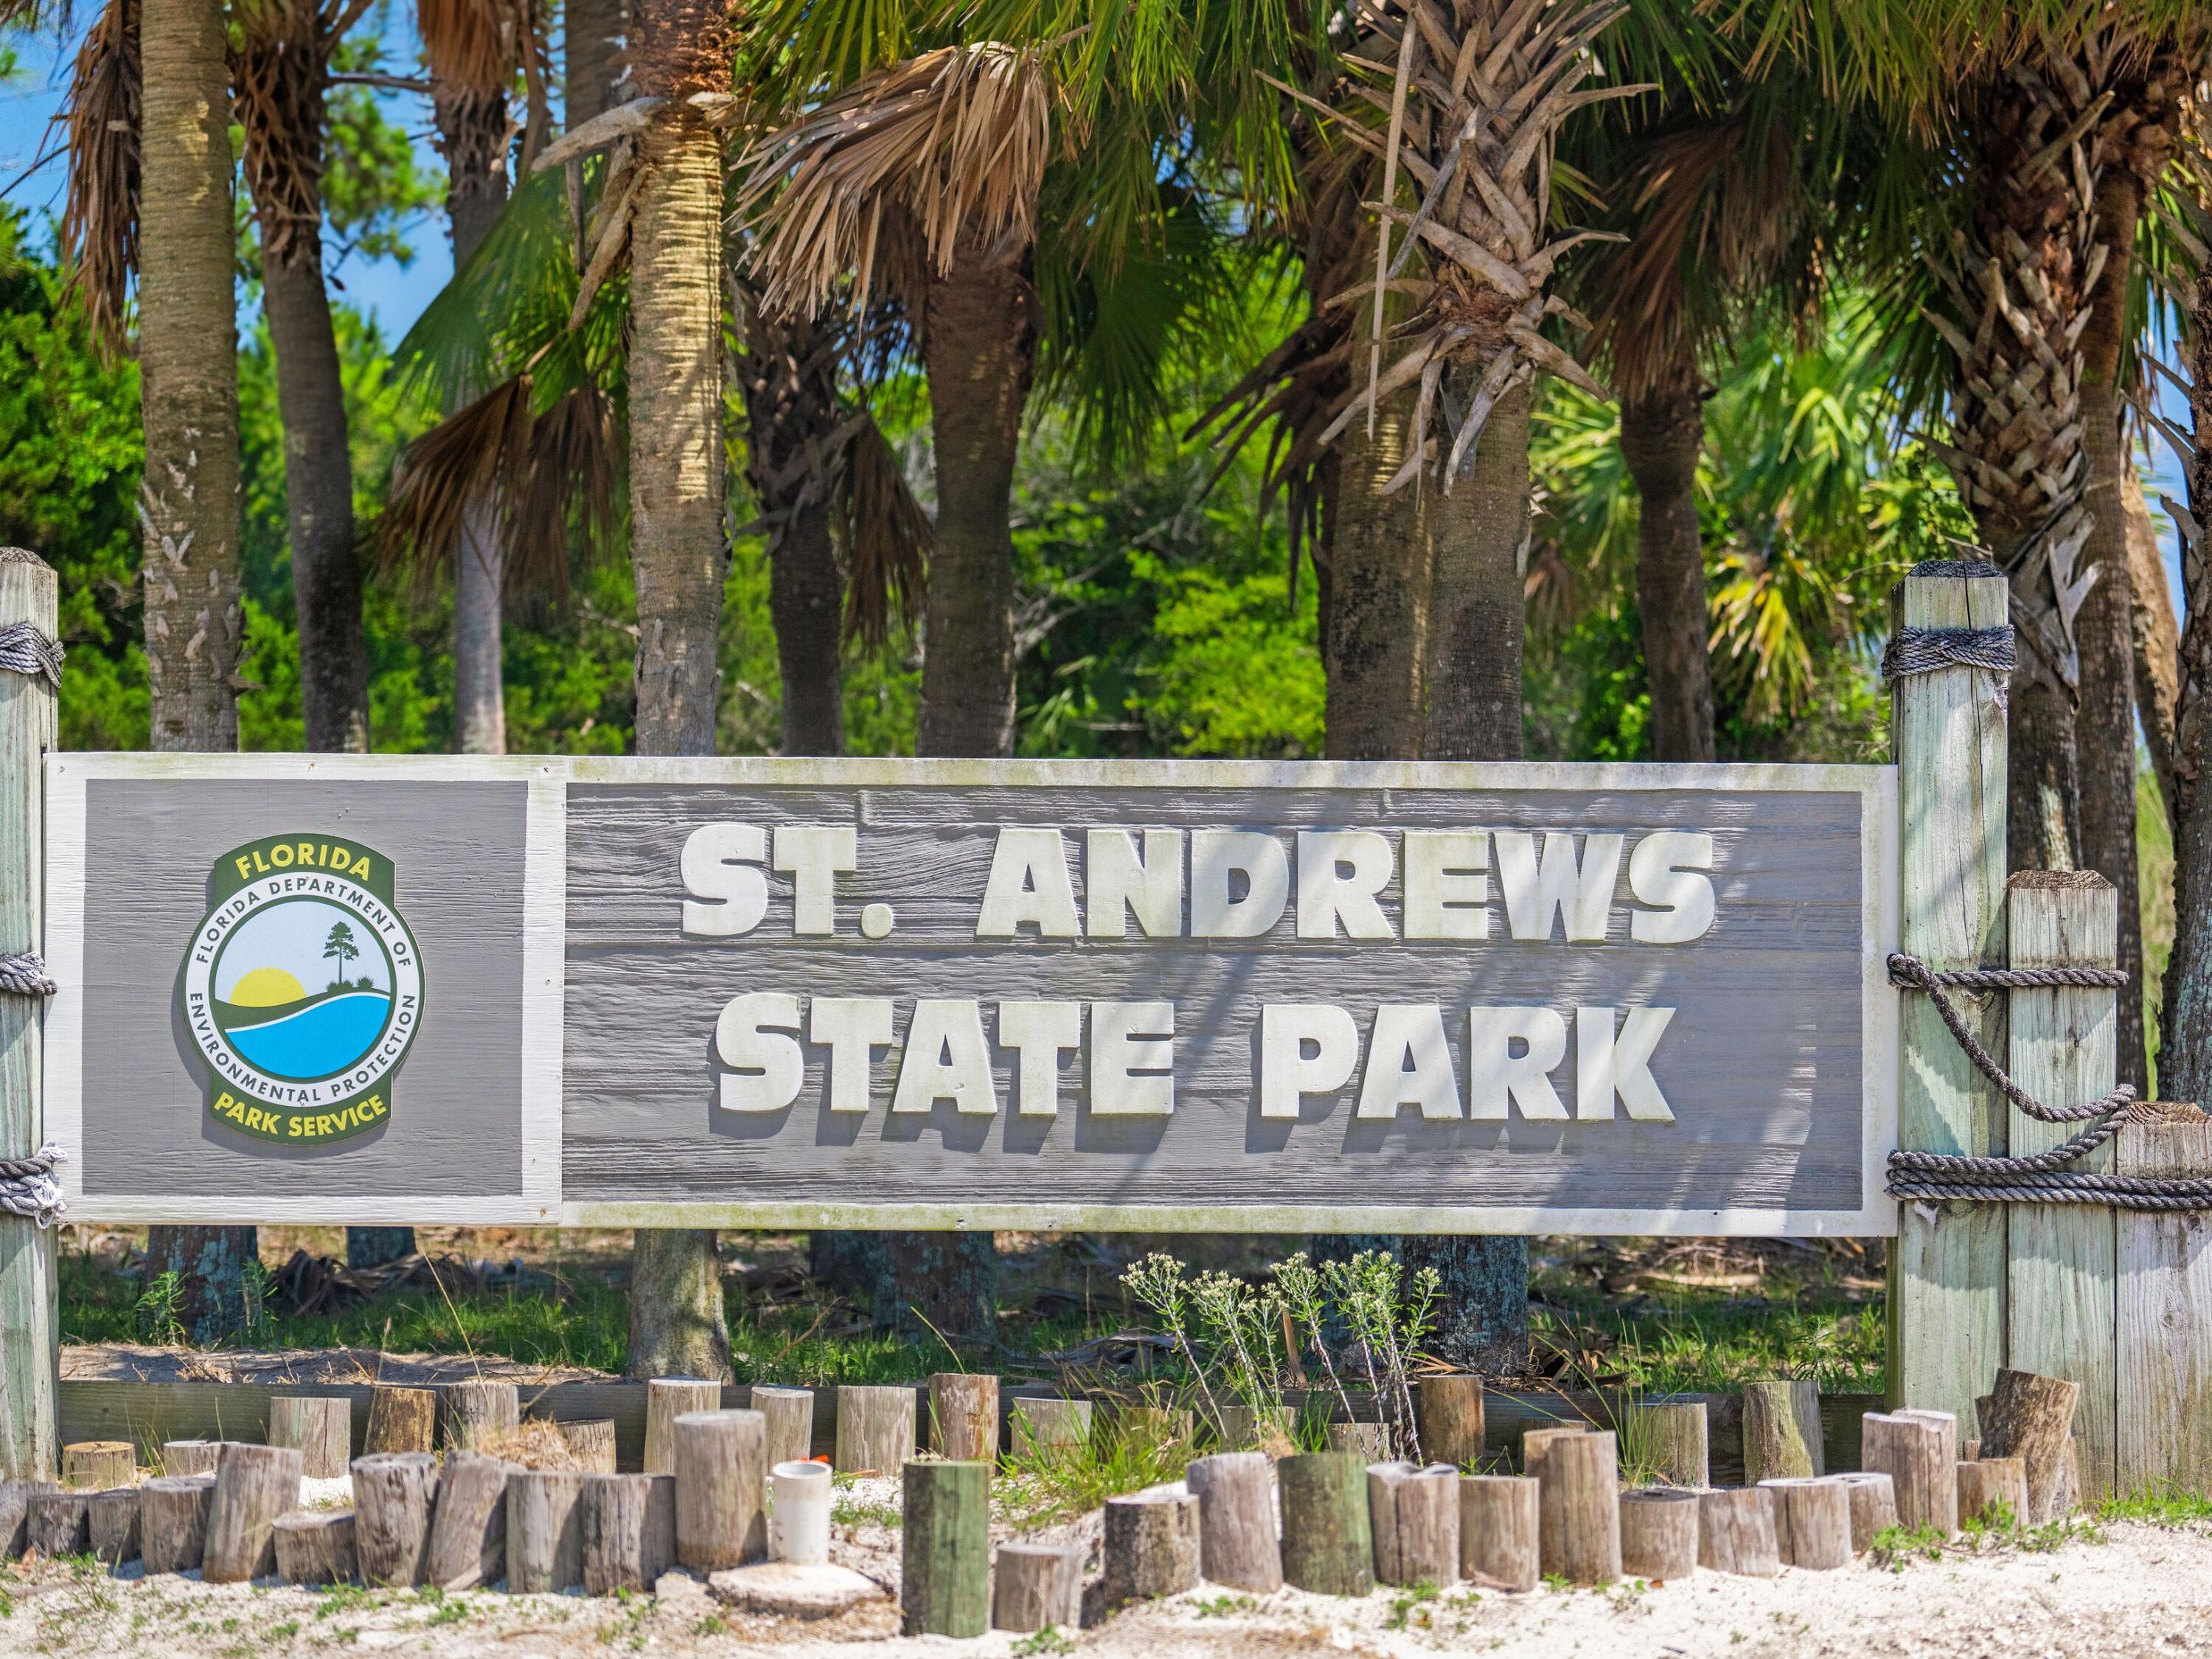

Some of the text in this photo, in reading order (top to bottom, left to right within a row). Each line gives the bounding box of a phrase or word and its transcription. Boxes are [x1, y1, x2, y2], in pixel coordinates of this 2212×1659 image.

[235, 843, 369, 881] FLORIDA
[681, 823, 1717, 943] ST. ANDREWS
[196, 877, 411, 967] FLORIDA DEPARTMENT OF
[189, 992, 416, 1102] ENVIRONMENTAL PROTECTION
[716, 992, 1677, 1120] STATE PARK
[214, 1092, 386, 1137] PARK SERVICE
